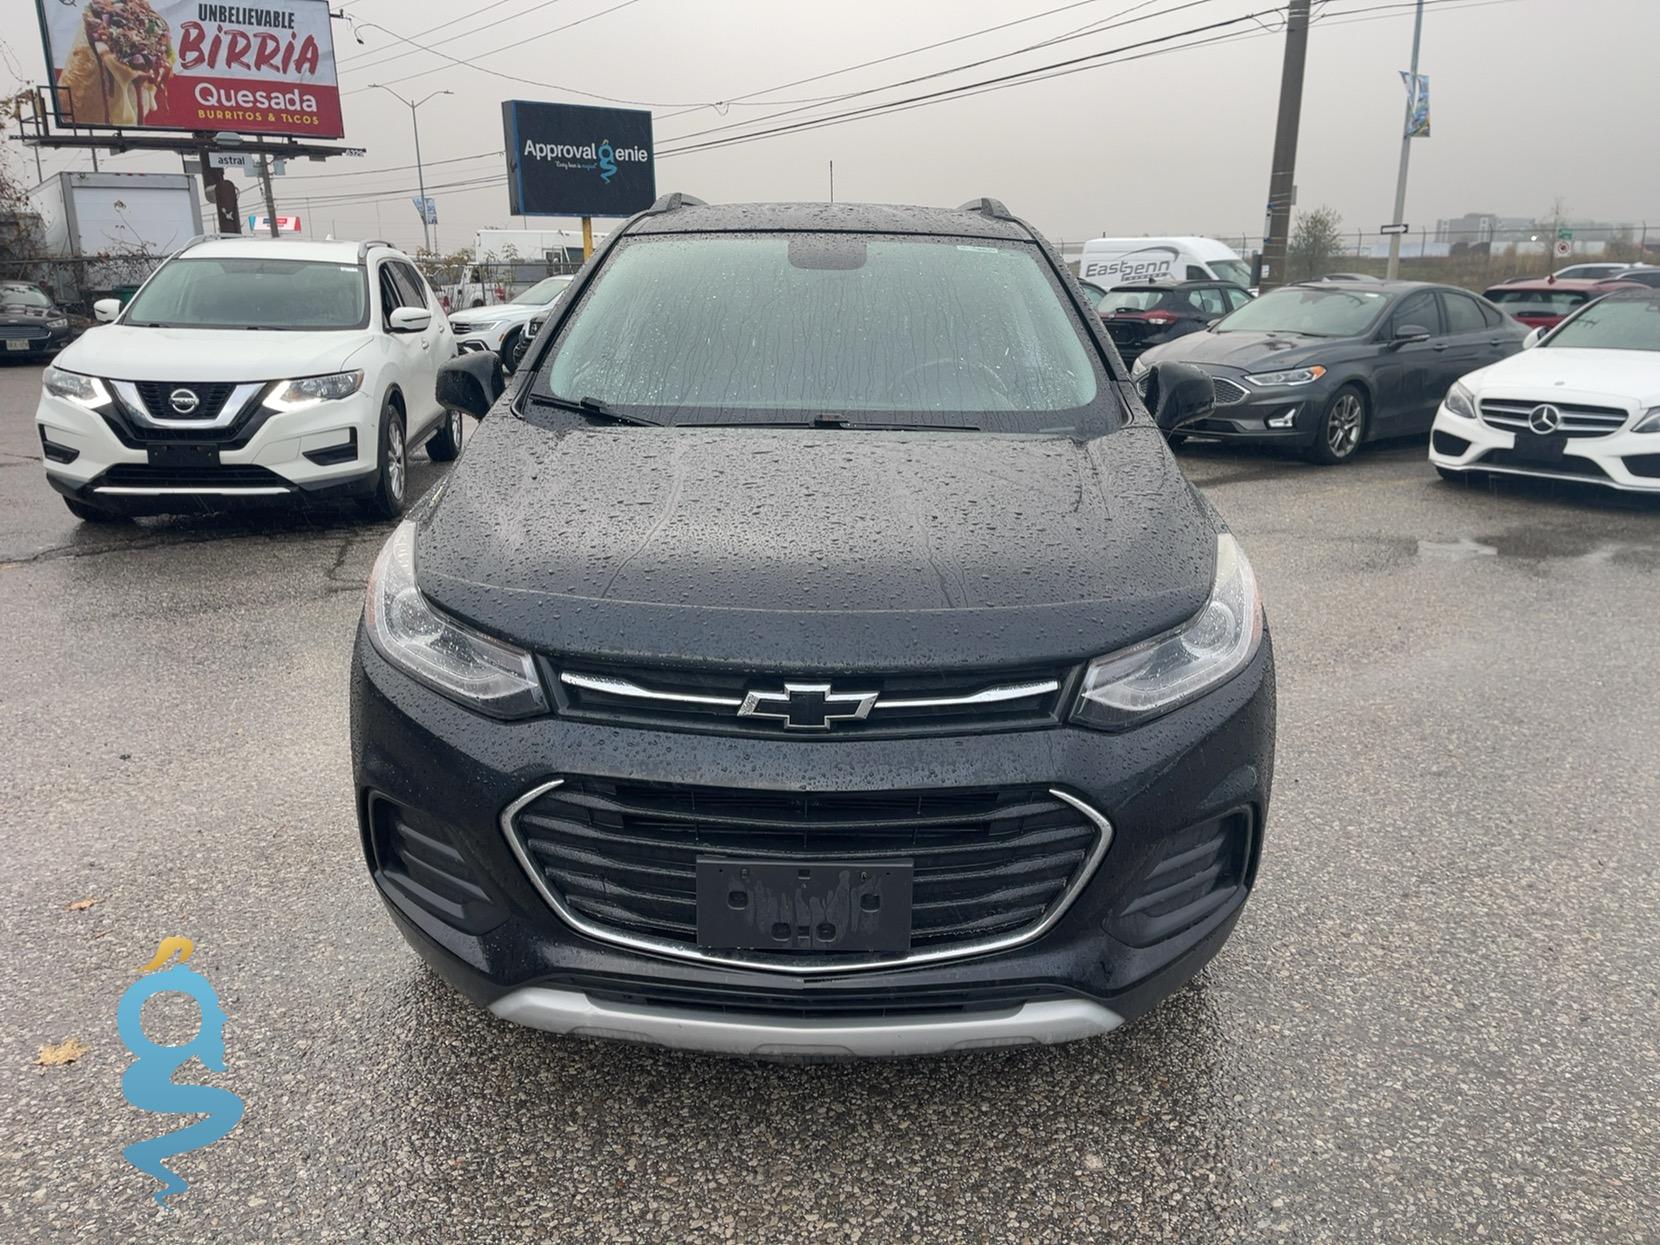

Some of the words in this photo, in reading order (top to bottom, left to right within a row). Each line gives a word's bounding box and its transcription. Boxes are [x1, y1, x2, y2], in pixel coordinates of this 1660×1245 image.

[198, 3, 295, 30] UNBELIEVABLE
[194, 82, 318, 113] Quesada
[197, 109, 262, 122] BURRITOS
[267, 112, 276, 122] &
[218, 155, 246, 166] astral
[524, 139, 597, 161] Approval
